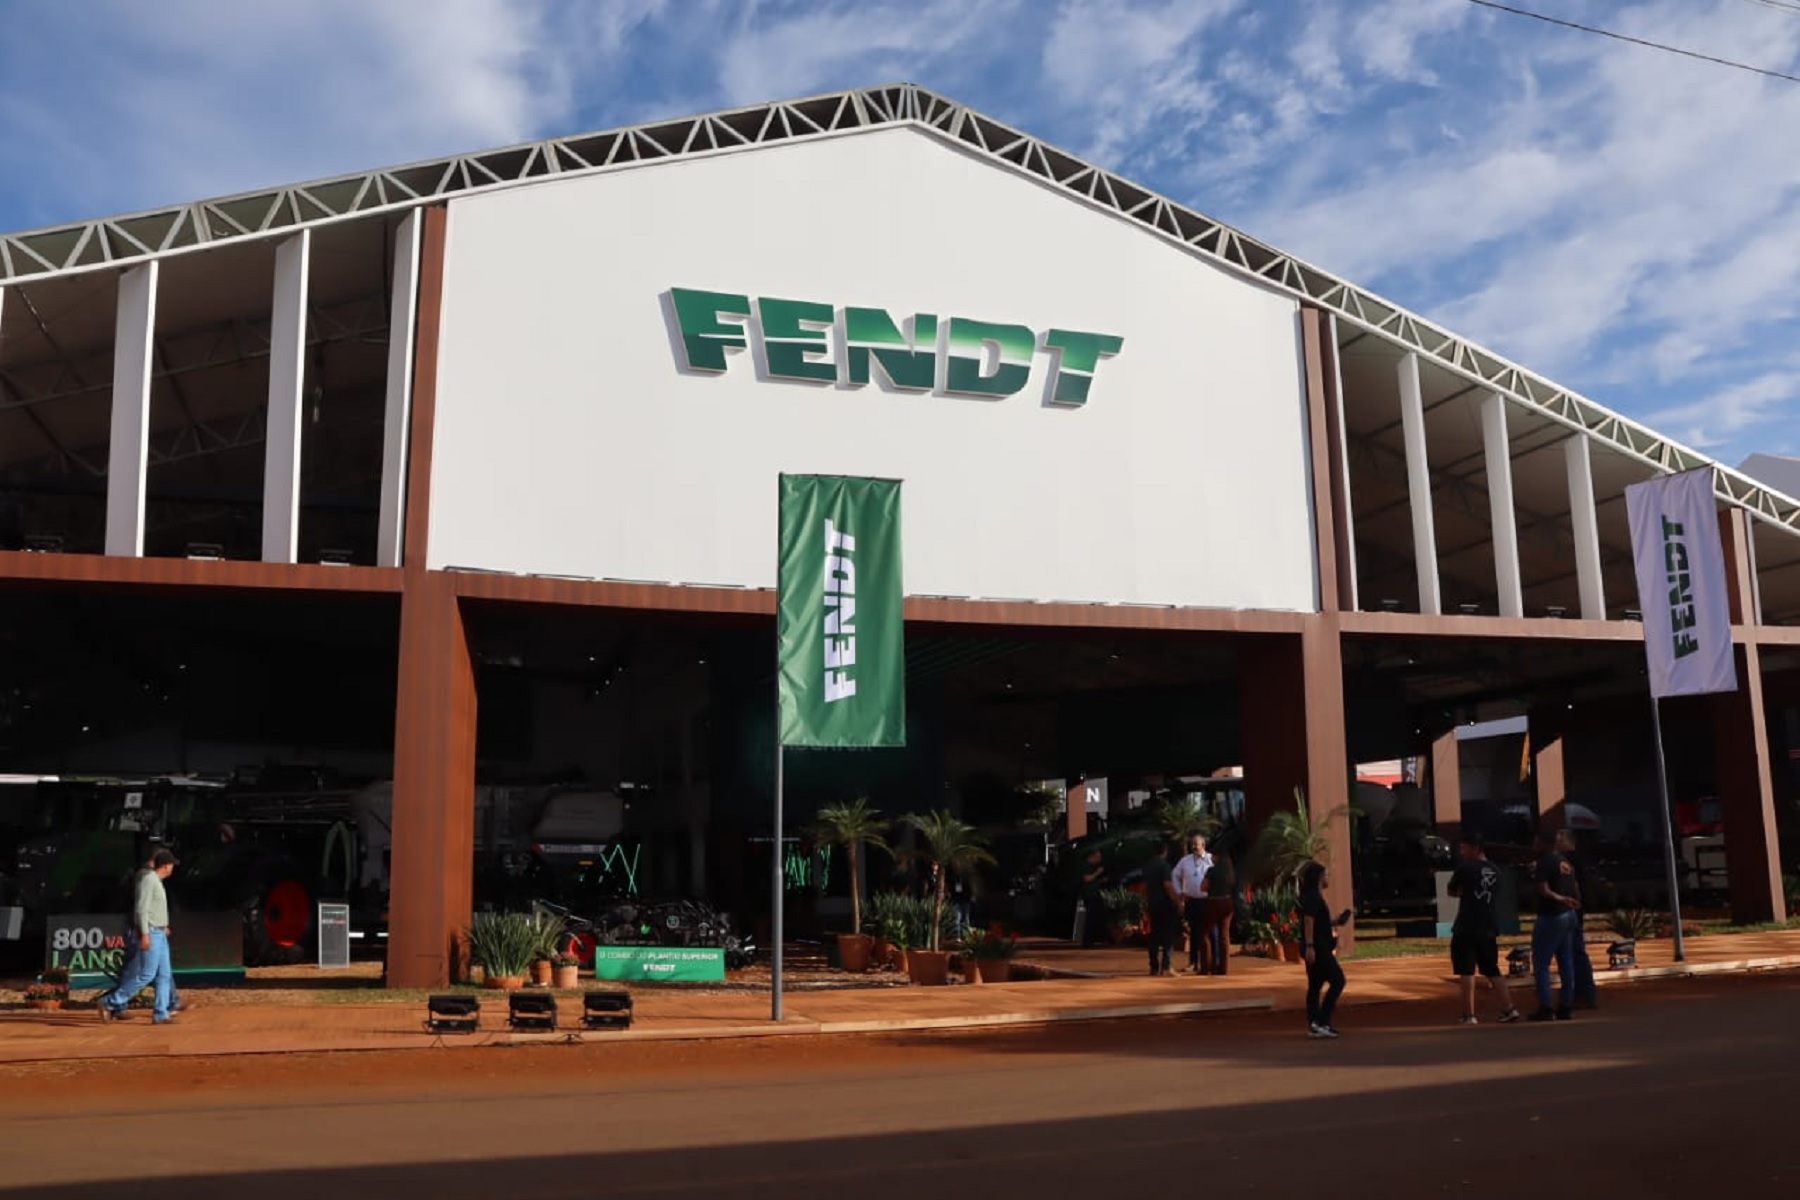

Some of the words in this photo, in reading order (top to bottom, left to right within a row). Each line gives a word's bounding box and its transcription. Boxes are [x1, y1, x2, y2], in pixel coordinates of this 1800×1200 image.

[660, 286, 1125, 409] FENDT
[823, 517, 857, 703] FENDT
[1661, 514, 1699, 660] FENDT
[52, 926, 104, 950] 800
[104, 935, 125, 948] VA
[643, 963, 676, 972] FENDT
[681, 951, 719, 961] SUPERIOR
